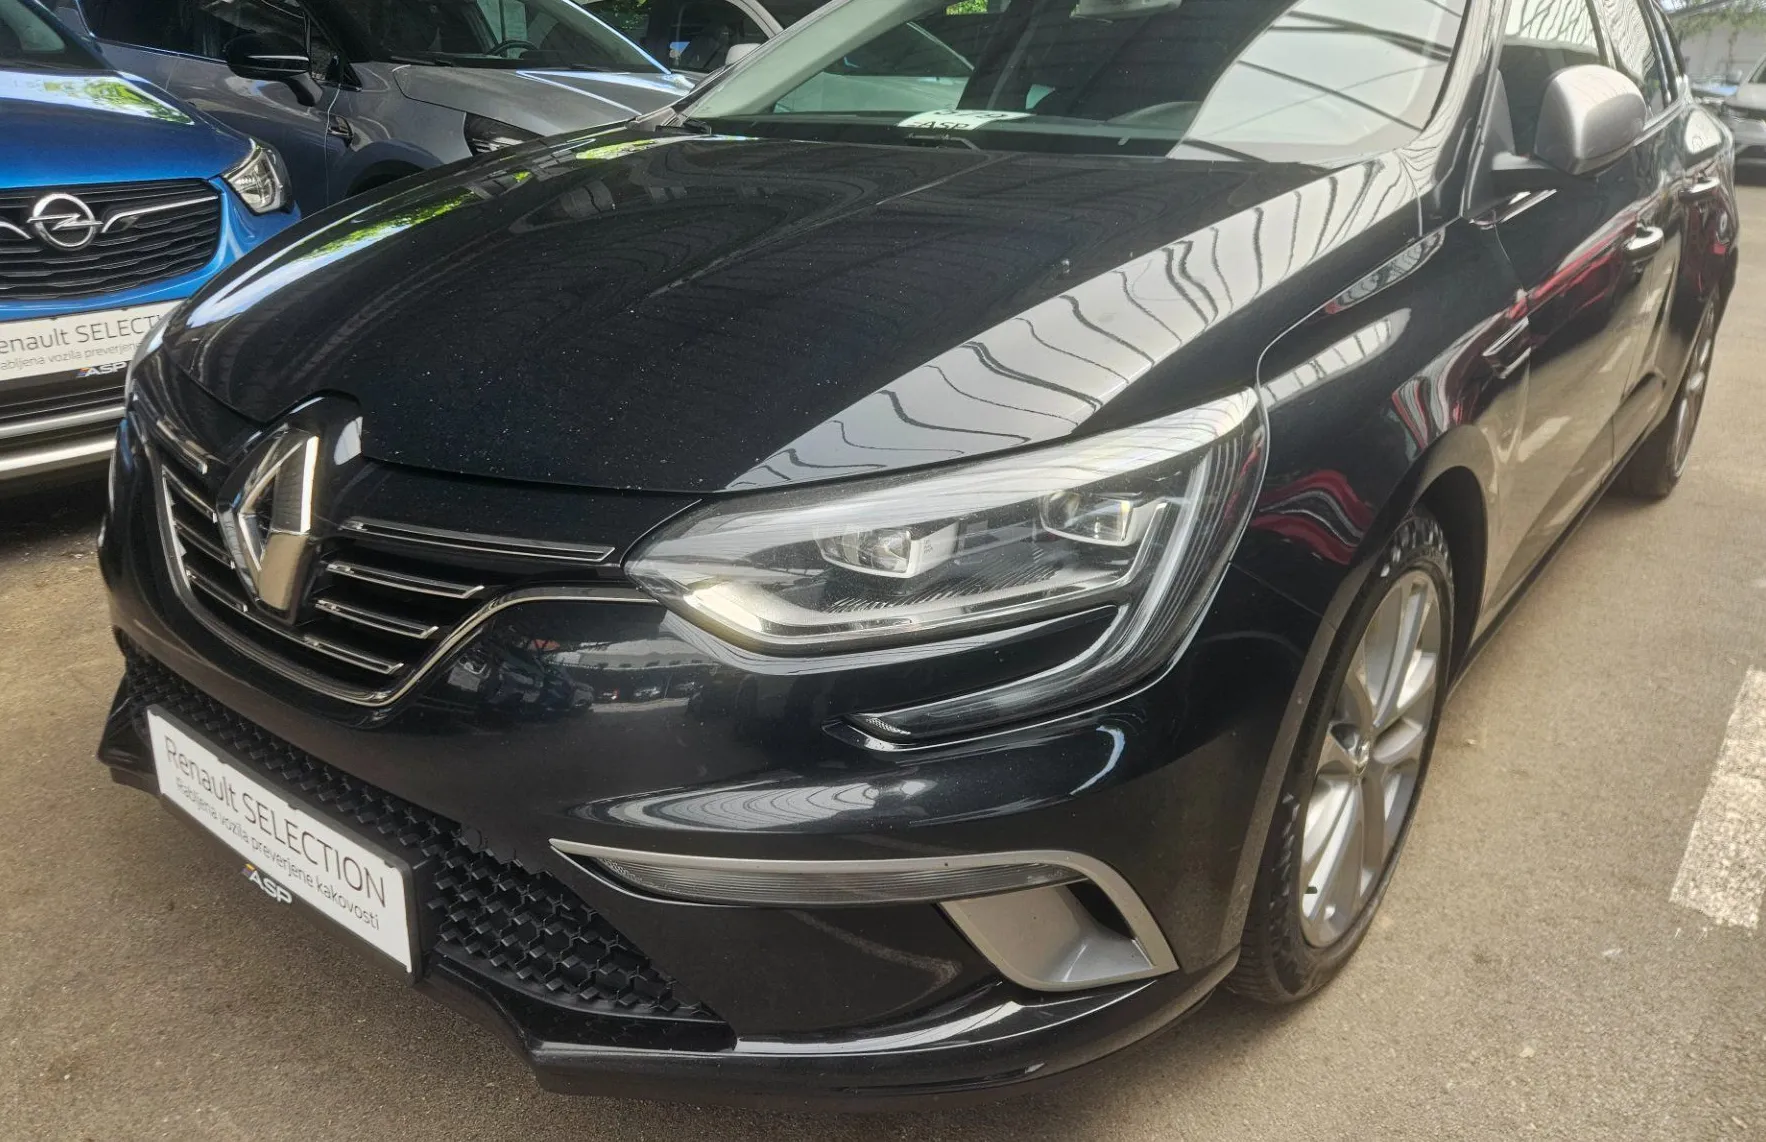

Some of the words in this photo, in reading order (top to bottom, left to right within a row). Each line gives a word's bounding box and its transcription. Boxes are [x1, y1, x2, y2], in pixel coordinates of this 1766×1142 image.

[921, 120, 970, 131] ASP
[75, 314, 160, 343] SELECT
[84, 361, 127, 377] ASP
[164, 735, 239, 814] Renault
[242, 792, 386, 908] SELECTION
[219, 813, 249, 844] vozila
[250, 836, 314, 887] preverjene
[316, 875, 380, 930] kakovosti
[248, 868, 293, 905] ASP
